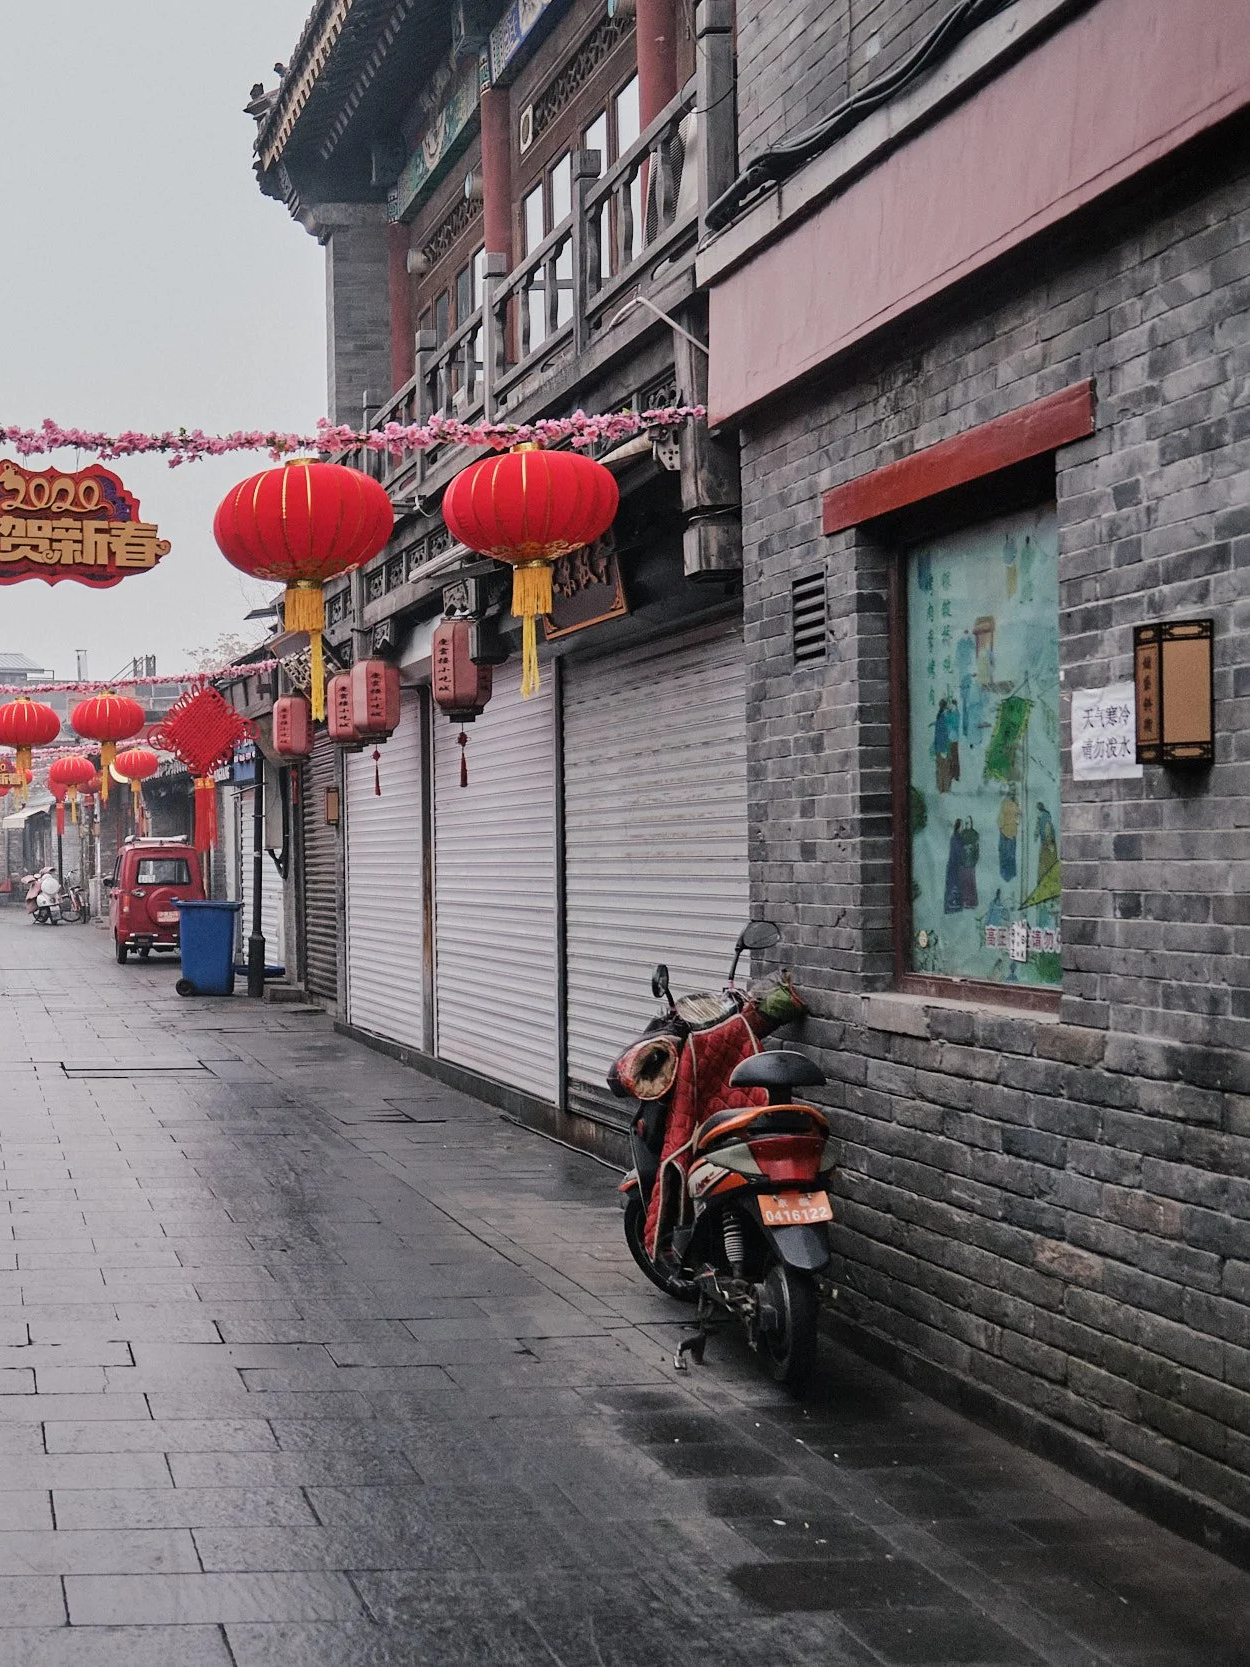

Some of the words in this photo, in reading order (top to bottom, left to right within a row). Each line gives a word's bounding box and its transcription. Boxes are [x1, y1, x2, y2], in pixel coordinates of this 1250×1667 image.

[1082, 703, 1131, 729] 天气寒冷
[765, 1207, 828, 1222] 0416122
